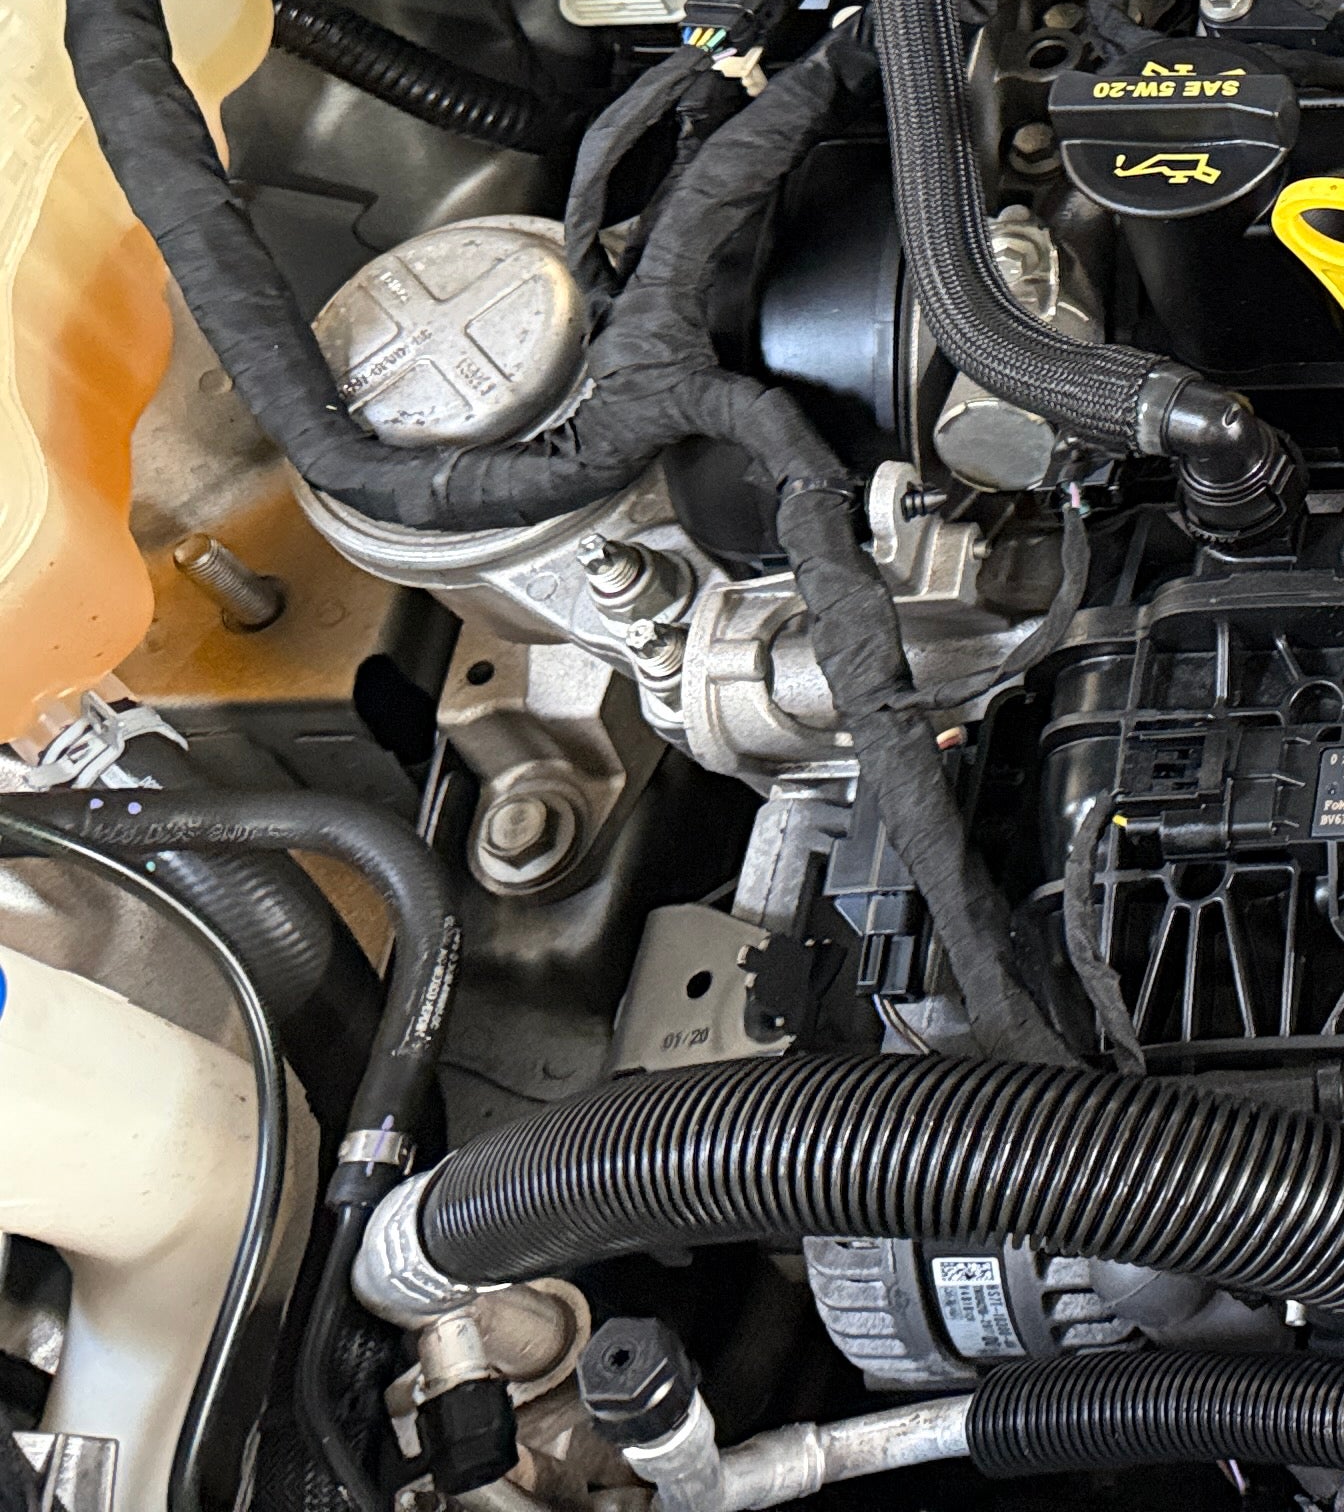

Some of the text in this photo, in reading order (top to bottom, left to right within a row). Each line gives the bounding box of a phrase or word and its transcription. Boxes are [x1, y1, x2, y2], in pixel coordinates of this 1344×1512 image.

[1092, 80, 1240, 98] SAE 5W-20
[662, 1026, 710, 1050] 01/20
